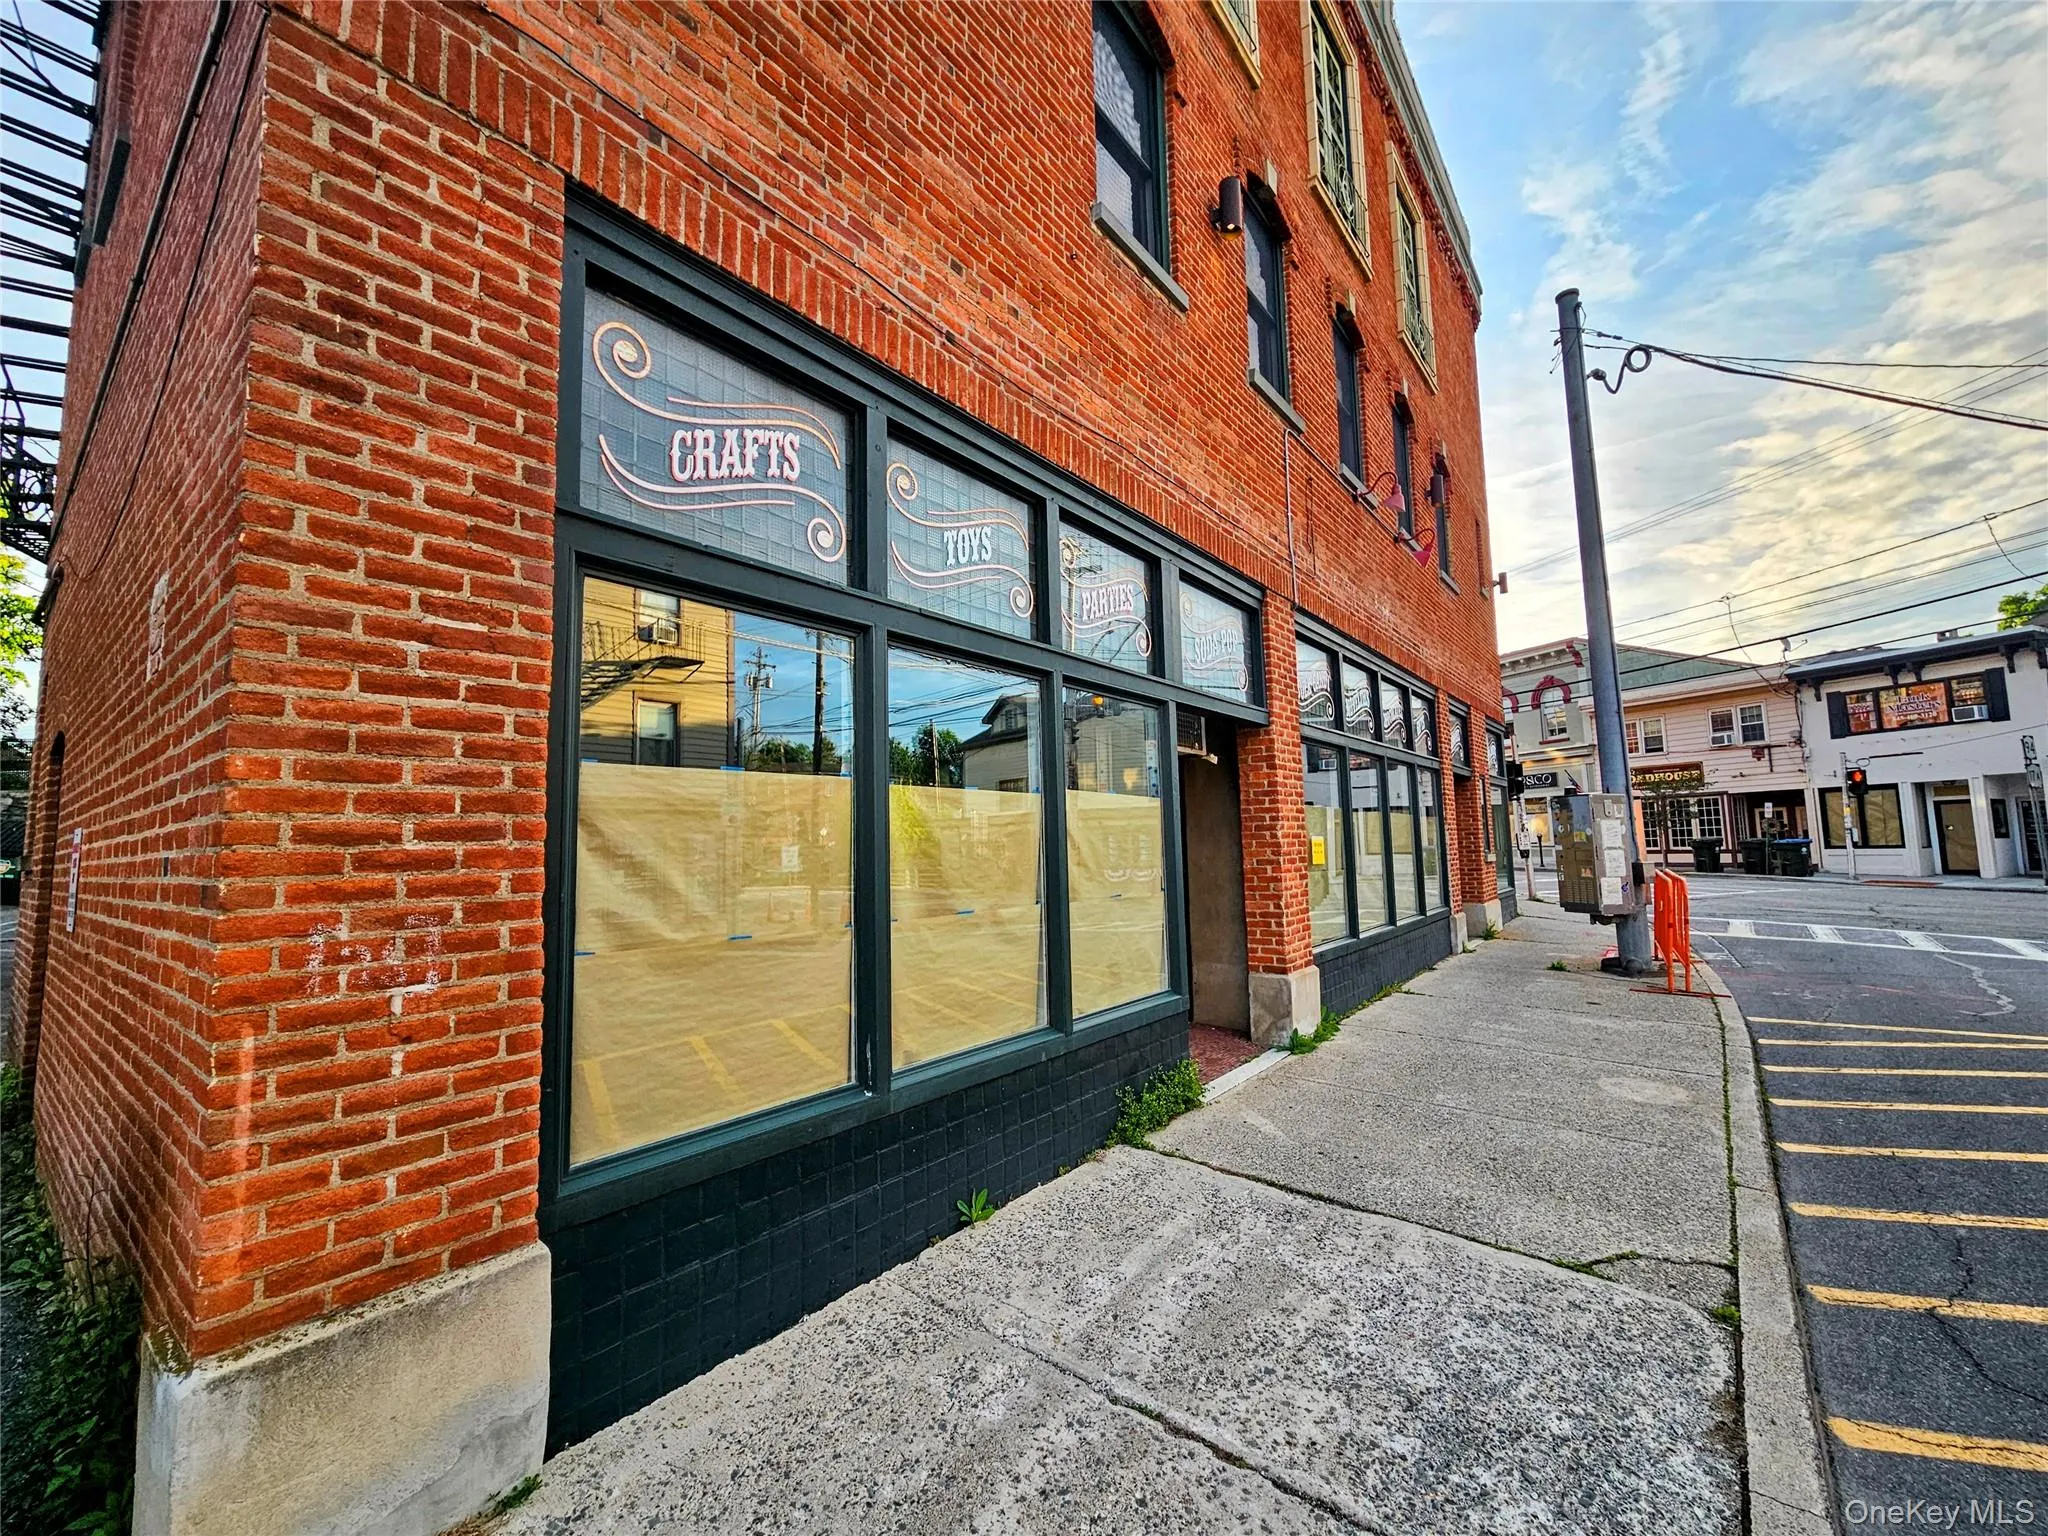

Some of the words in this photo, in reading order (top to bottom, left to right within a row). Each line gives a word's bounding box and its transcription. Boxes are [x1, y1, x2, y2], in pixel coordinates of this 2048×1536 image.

[669, 428, 801, 482] CRAFTS
[943, 526, 992, 566] TOYS
[1081, 583, 1134, 621] PARTIES
[1523, 773, 1552, 786] &CO
